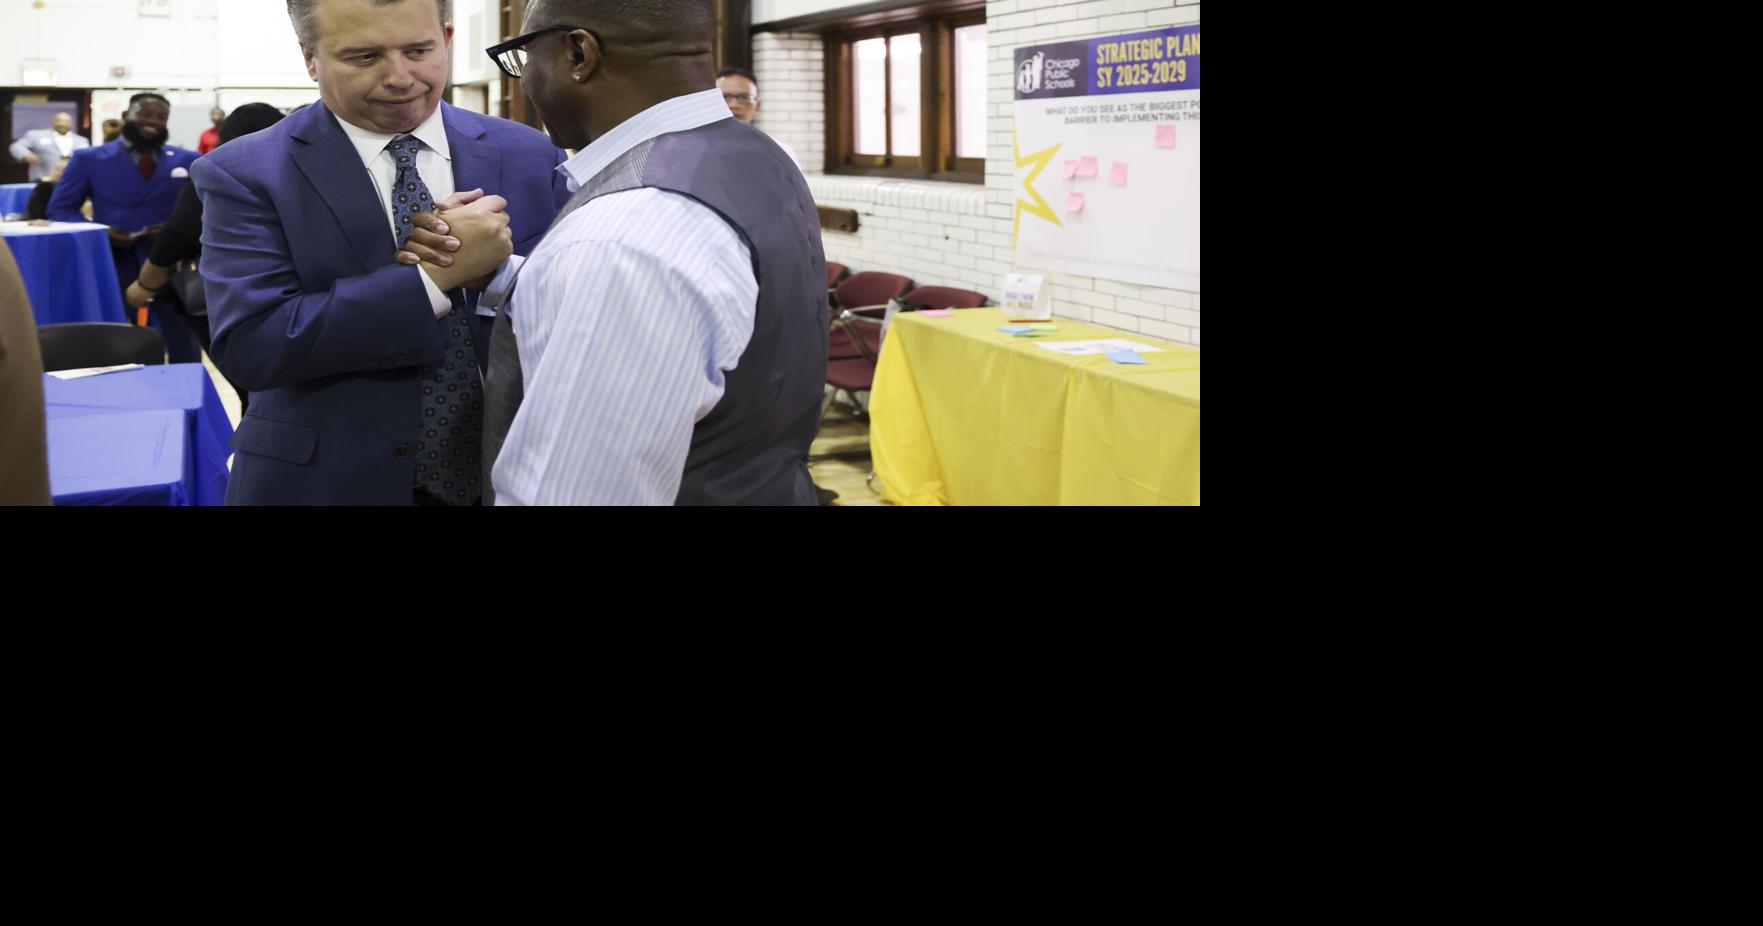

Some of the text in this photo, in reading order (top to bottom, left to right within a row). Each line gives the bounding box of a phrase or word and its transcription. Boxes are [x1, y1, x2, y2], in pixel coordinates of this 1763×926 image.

[1096, 37, 1163, 65] STRATEGIC
[1044, 58, 1081, 70] Chicago
[1044, 69, 1070, 80] Public
[1096, 59, 1187, 89] SY 2025-2029
[1044, 78, 1076, 90] Schools
[1046, 106, 1066, 115] WHAT
[1081, 105, 1098, 114] YOU
[1100, 104, 1115, 113] SEE
[1117, 103, 1128, 112] AS
[1130, 102, 1147, 112] THE
[1149, 100, 1188, 111] BIGGEST
[1064, 114, 1098, 125] BARRIER
[1100, 114, 1111, 124] TO
[1113, 111, 1181, 123] IMPLEMENTING
